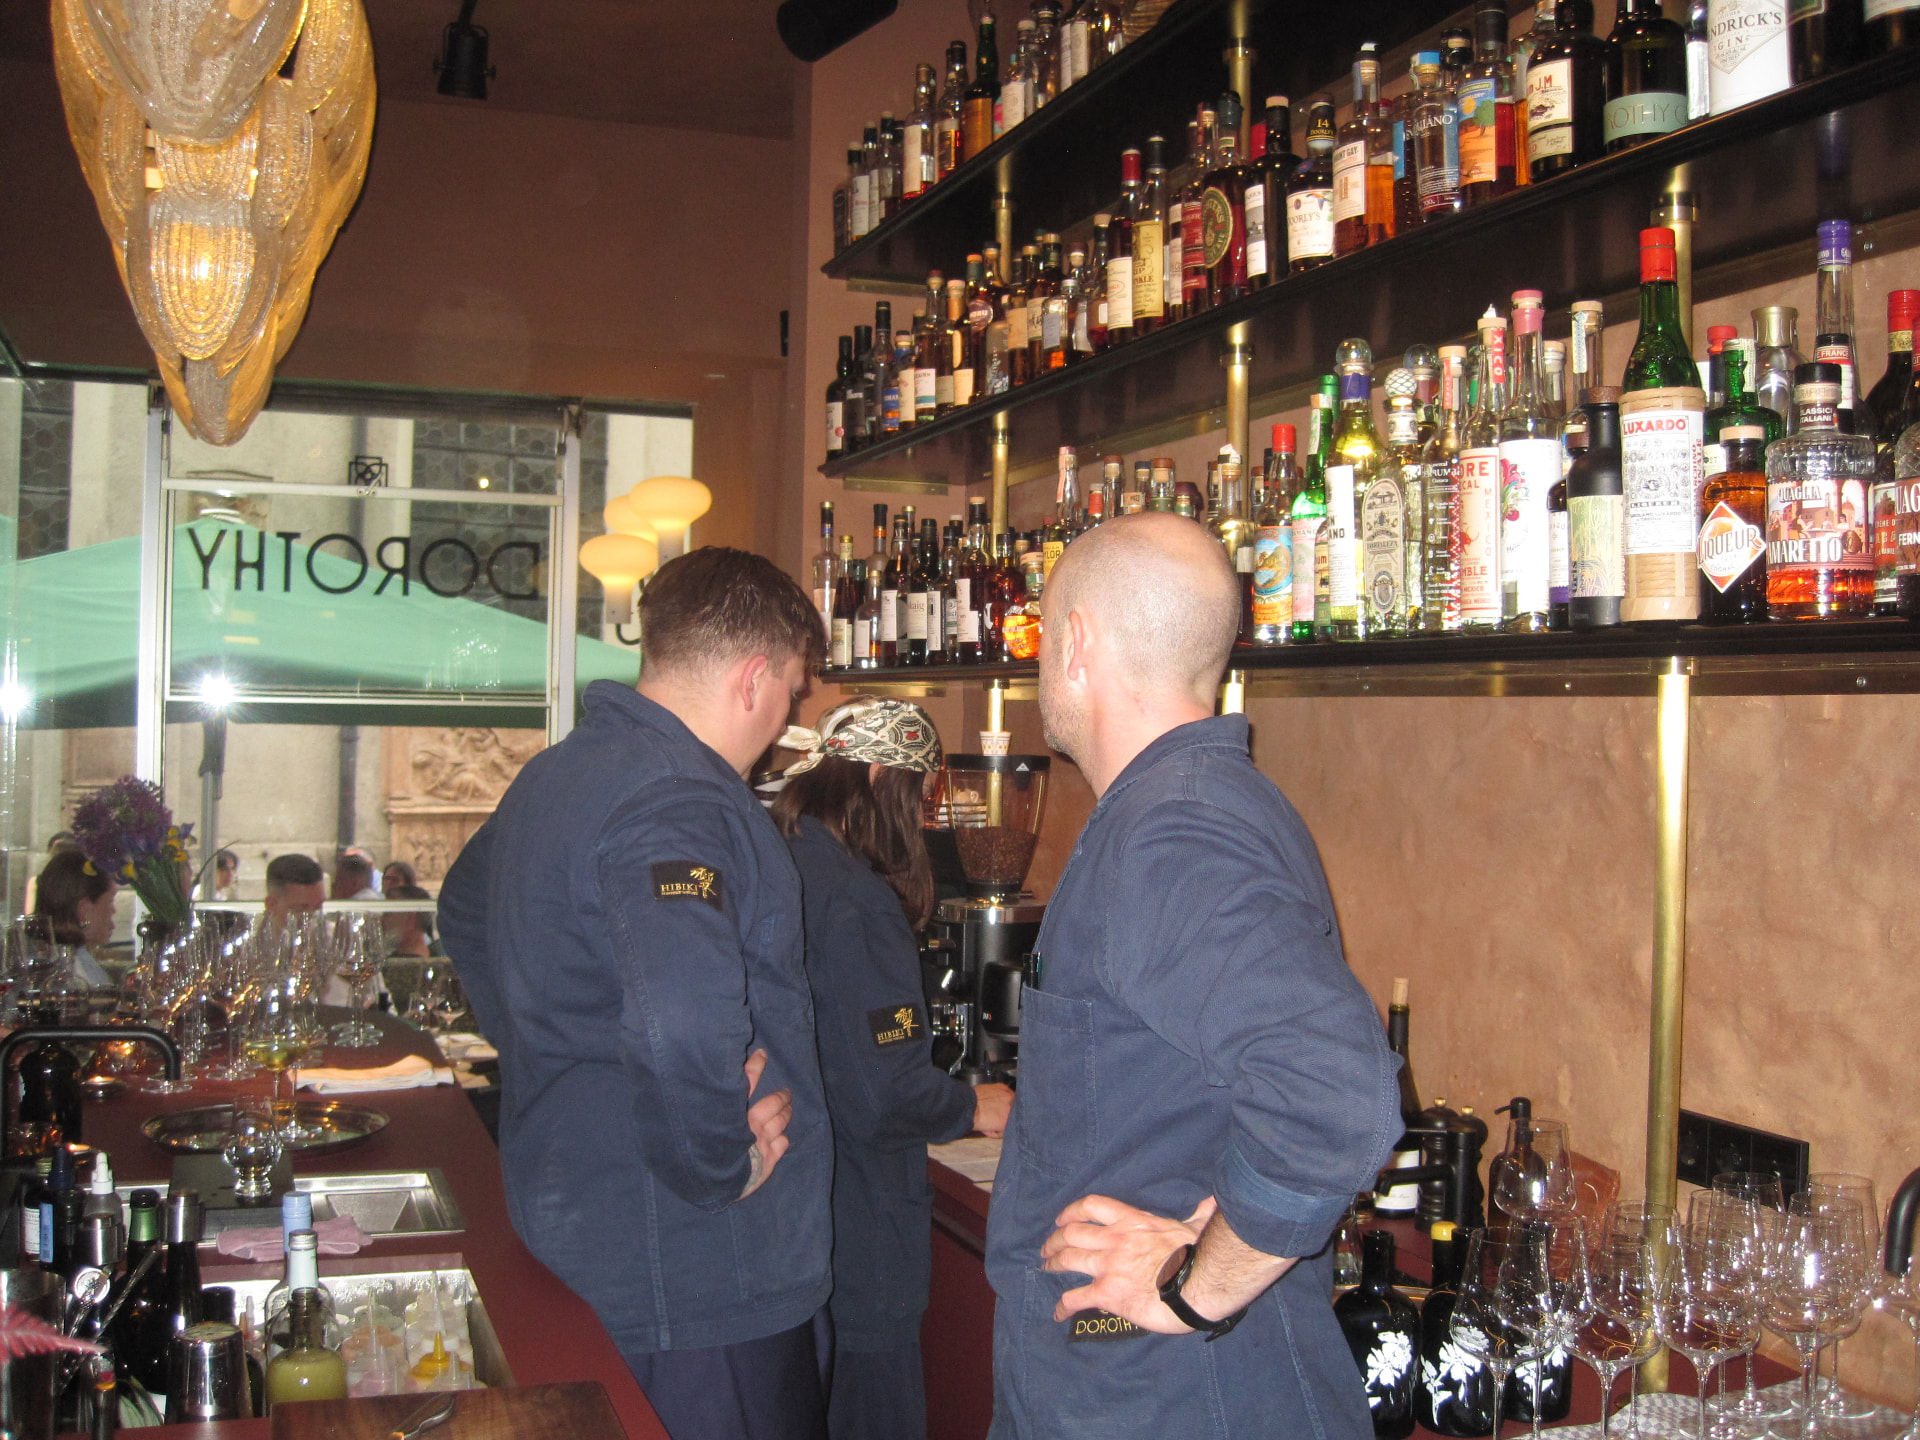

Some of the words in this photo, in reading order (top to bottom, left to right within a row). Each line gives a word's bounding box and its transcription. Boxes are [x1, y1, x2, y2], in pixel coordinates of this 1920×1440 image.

[1709, 12, 1782, 39] NDRICK'S
[1717, 35, 1743, 51] GIN
[1317, 119, 1330, 128] 14
[1608, 103, 1669, 129] ROTHY
[1493, 334, 1503, 376] XICO
[1623, 418, 1687, 436] LUXARDO
[1778, 485, 1823, 503] QUAGLIA
[1698, 527, 1762, 567] LIQUEUR
[1766, 536, 1842, 565] AMARETTO
[660, 883, 698, 891] HIBIKI
[876, 1029, 904, 1041] HIBIKI
[1075, 1316, 1139, 1334] DOROTH
